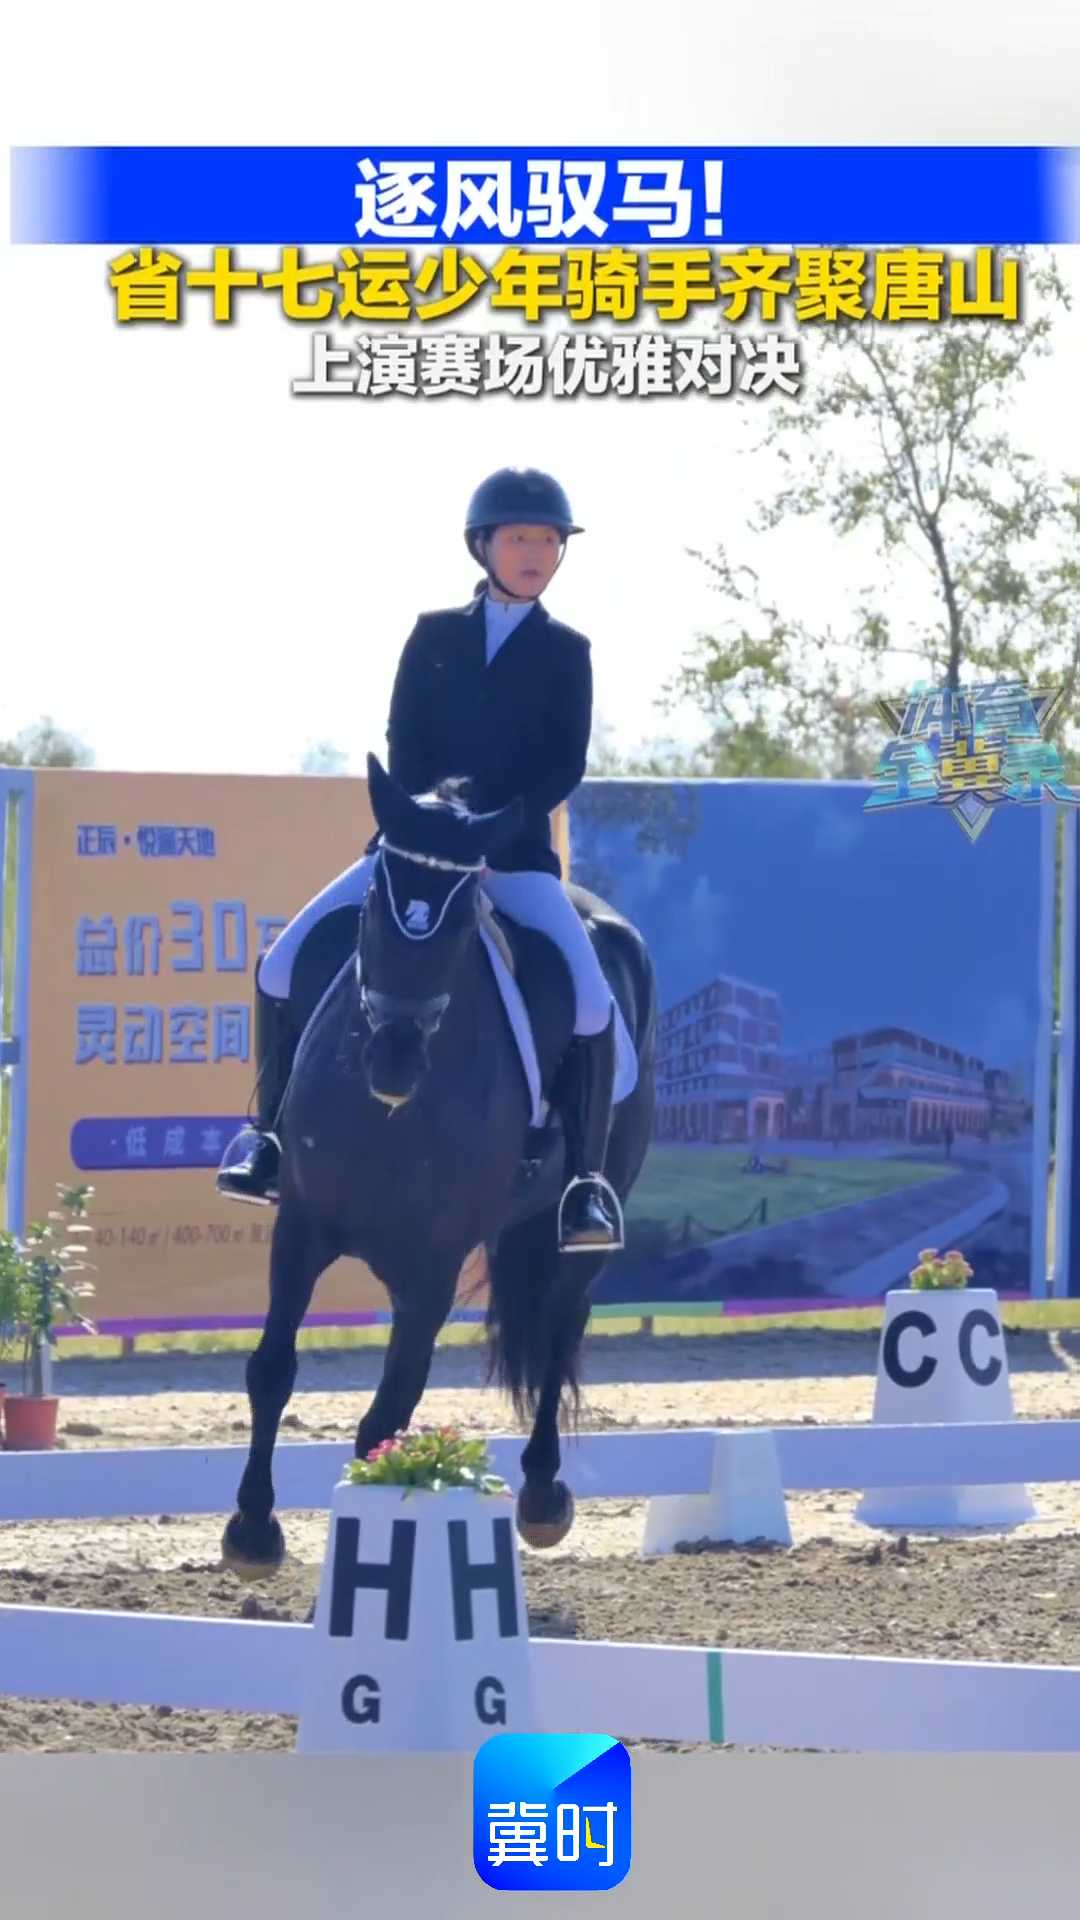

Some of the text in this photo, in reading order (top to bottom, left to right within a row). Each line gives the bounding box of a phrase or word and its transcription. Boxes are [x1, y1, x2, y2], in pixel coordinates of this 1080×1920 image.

[76, 1004, 250, 1064] 灵动空间
[883, 1308, 1002, 1388] C C
[329, 1517, 519, 1641] H H
[341, 1674, 507, 1725] G G
